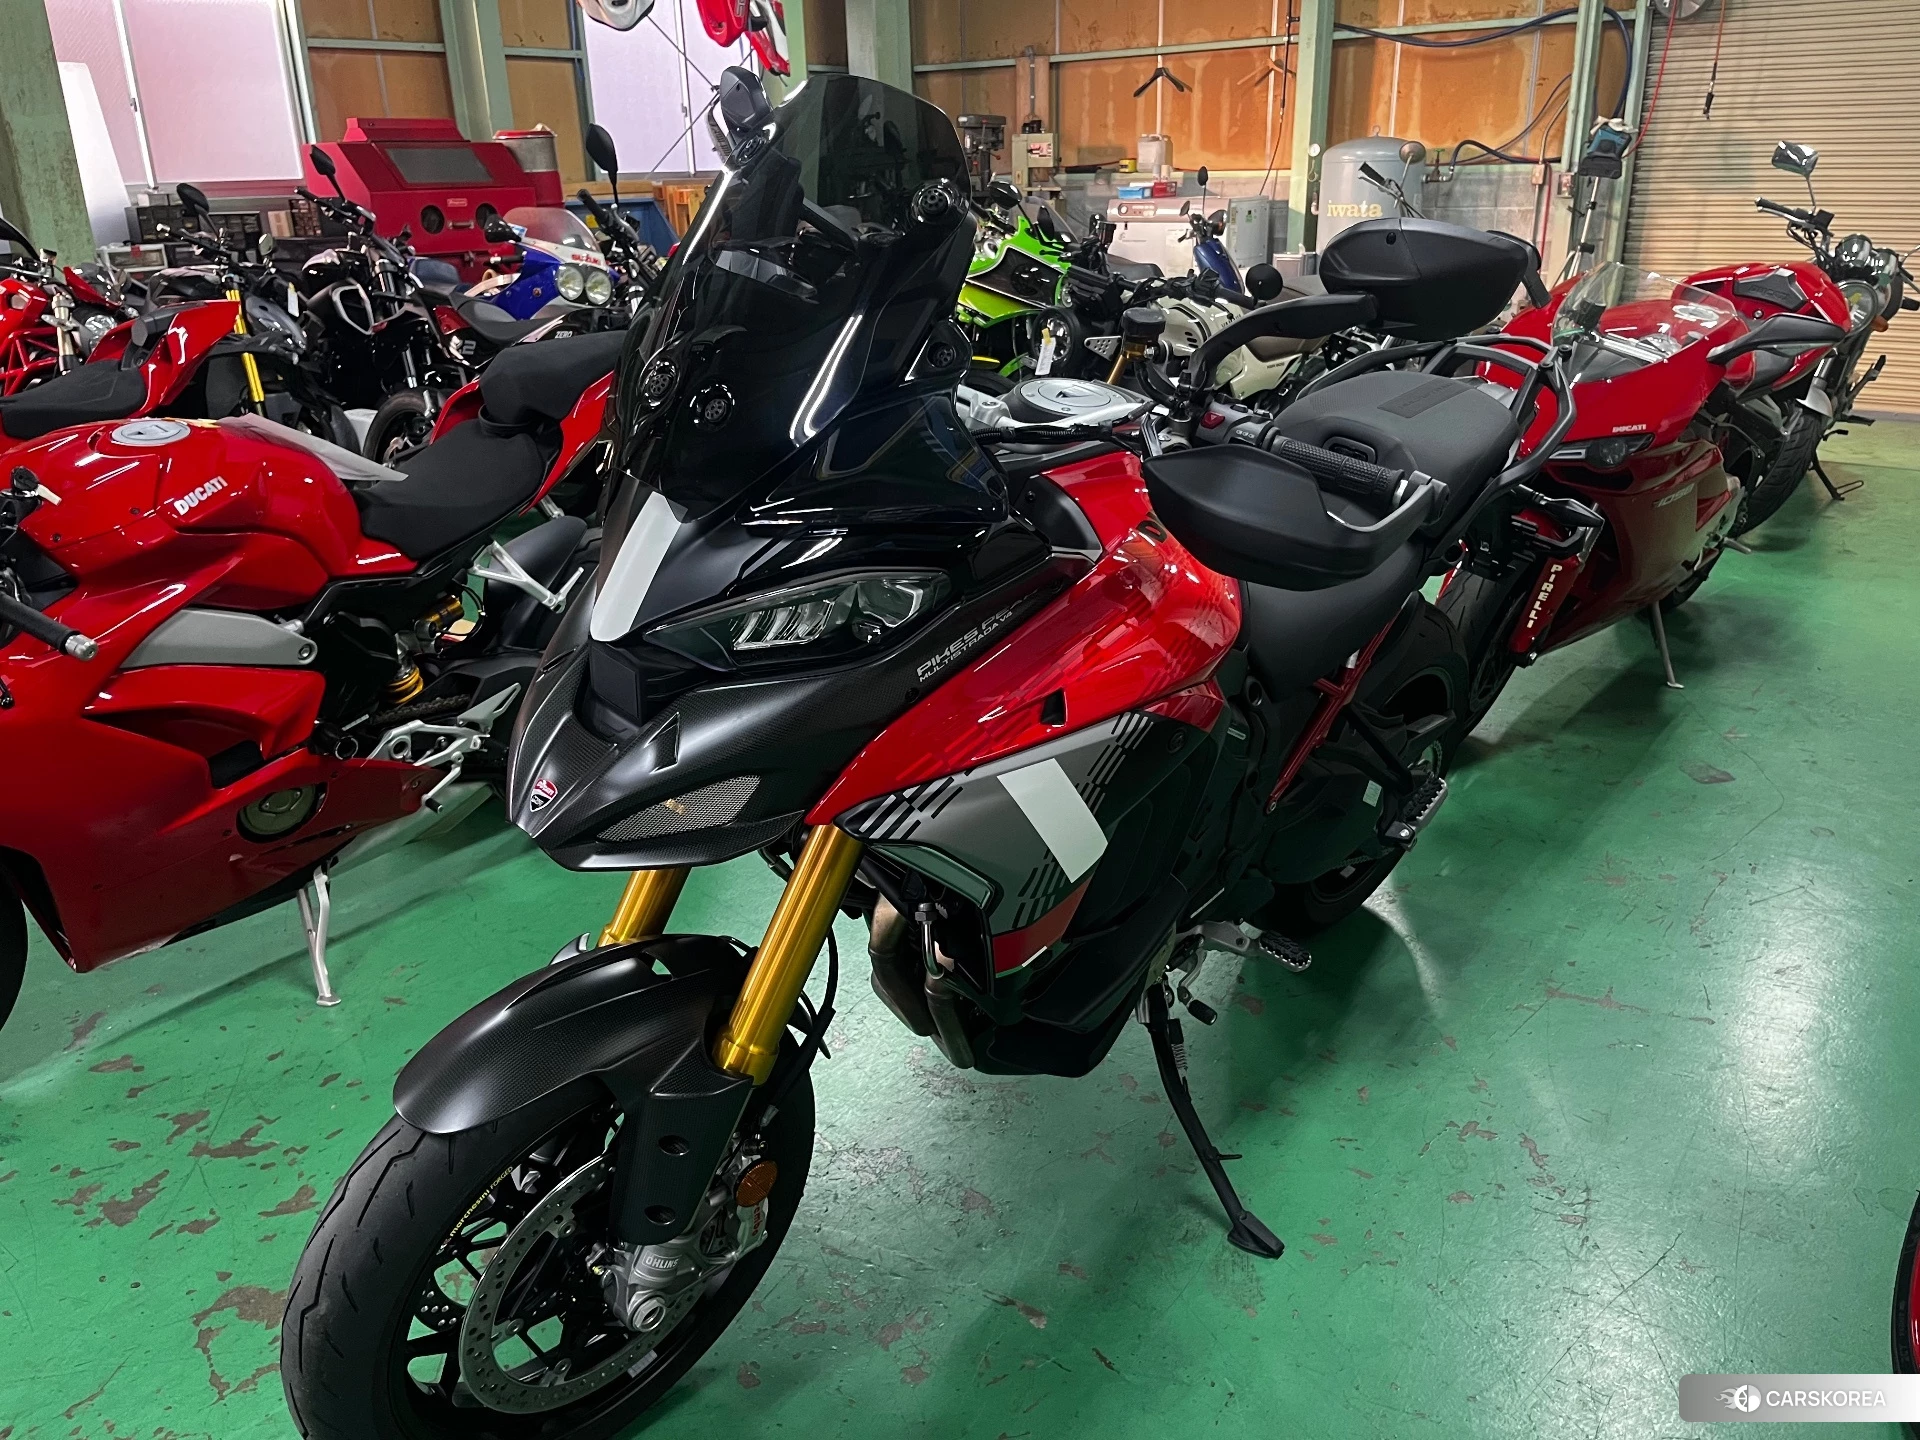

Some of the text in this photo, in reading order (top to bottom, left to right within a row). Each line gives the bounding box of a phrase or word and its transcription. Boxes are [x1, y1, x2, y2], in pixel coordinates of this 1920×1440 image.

[1326, 199, 1383, 218] iwata
[554, 330, 573, 339] ZERO
[1612, 423, 1647, 433] DUCATI
[173, 475, 229, 516] DUCATI
[1526, 564, 1563, 629] PIRELLI
[916, 626, 979, 677] PIKES
[919, 622, 999, 683] MULTISTRADA
[751, 1203, 764, 1237] embo
